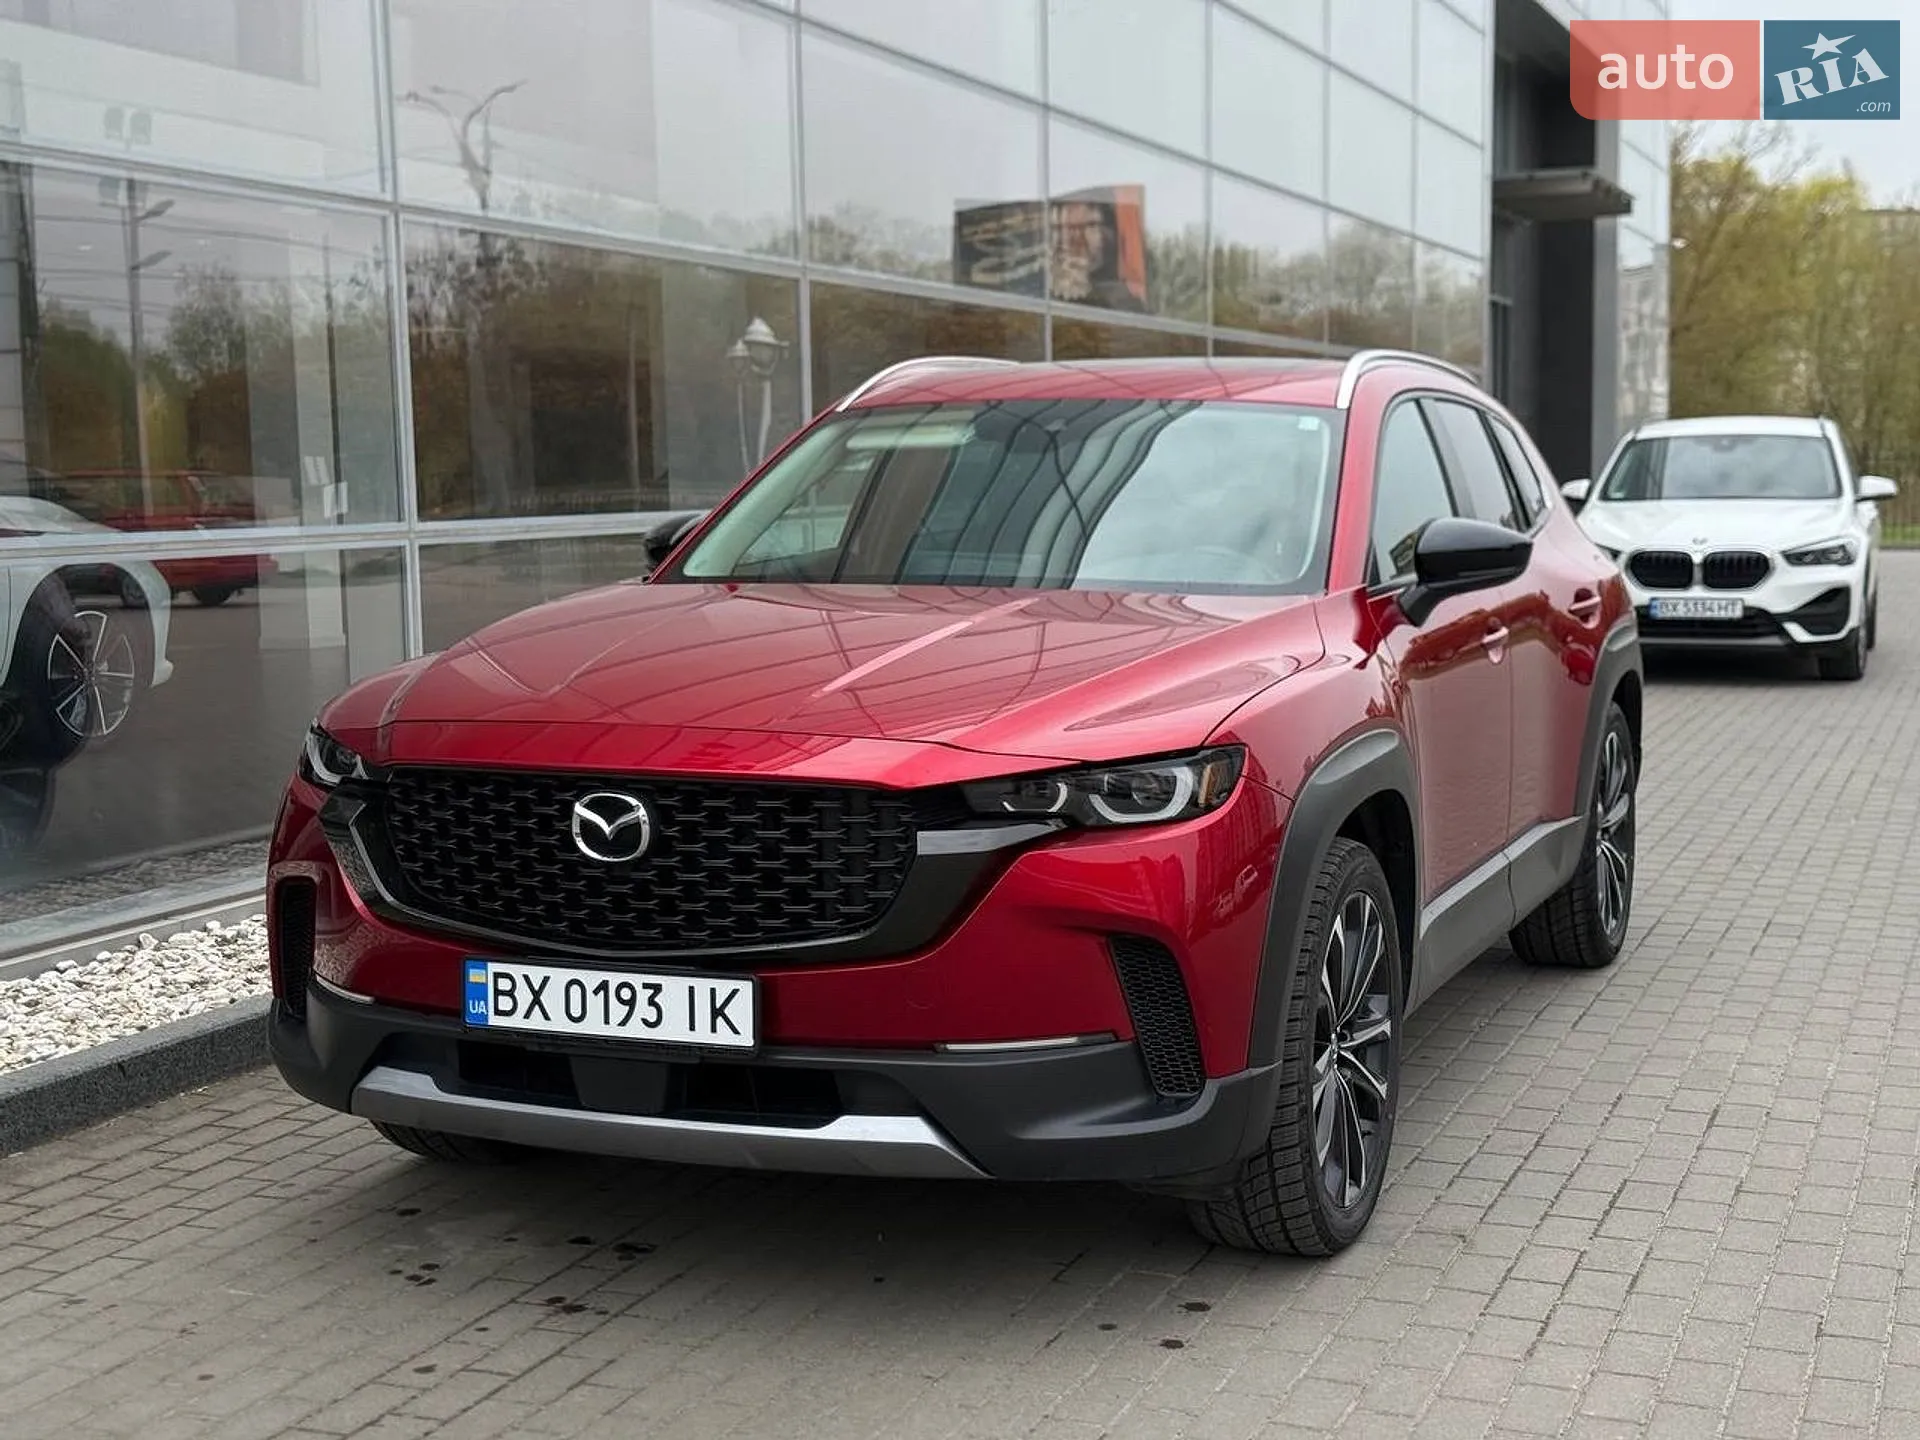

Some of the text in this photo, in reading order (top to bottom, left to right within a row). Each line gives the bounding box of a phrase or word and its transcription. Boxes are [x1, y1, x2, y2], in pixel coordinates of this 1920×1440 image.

[469, 999, 488, 1015] UA
[493, 971, 742, 1035] BX 0193 IK
